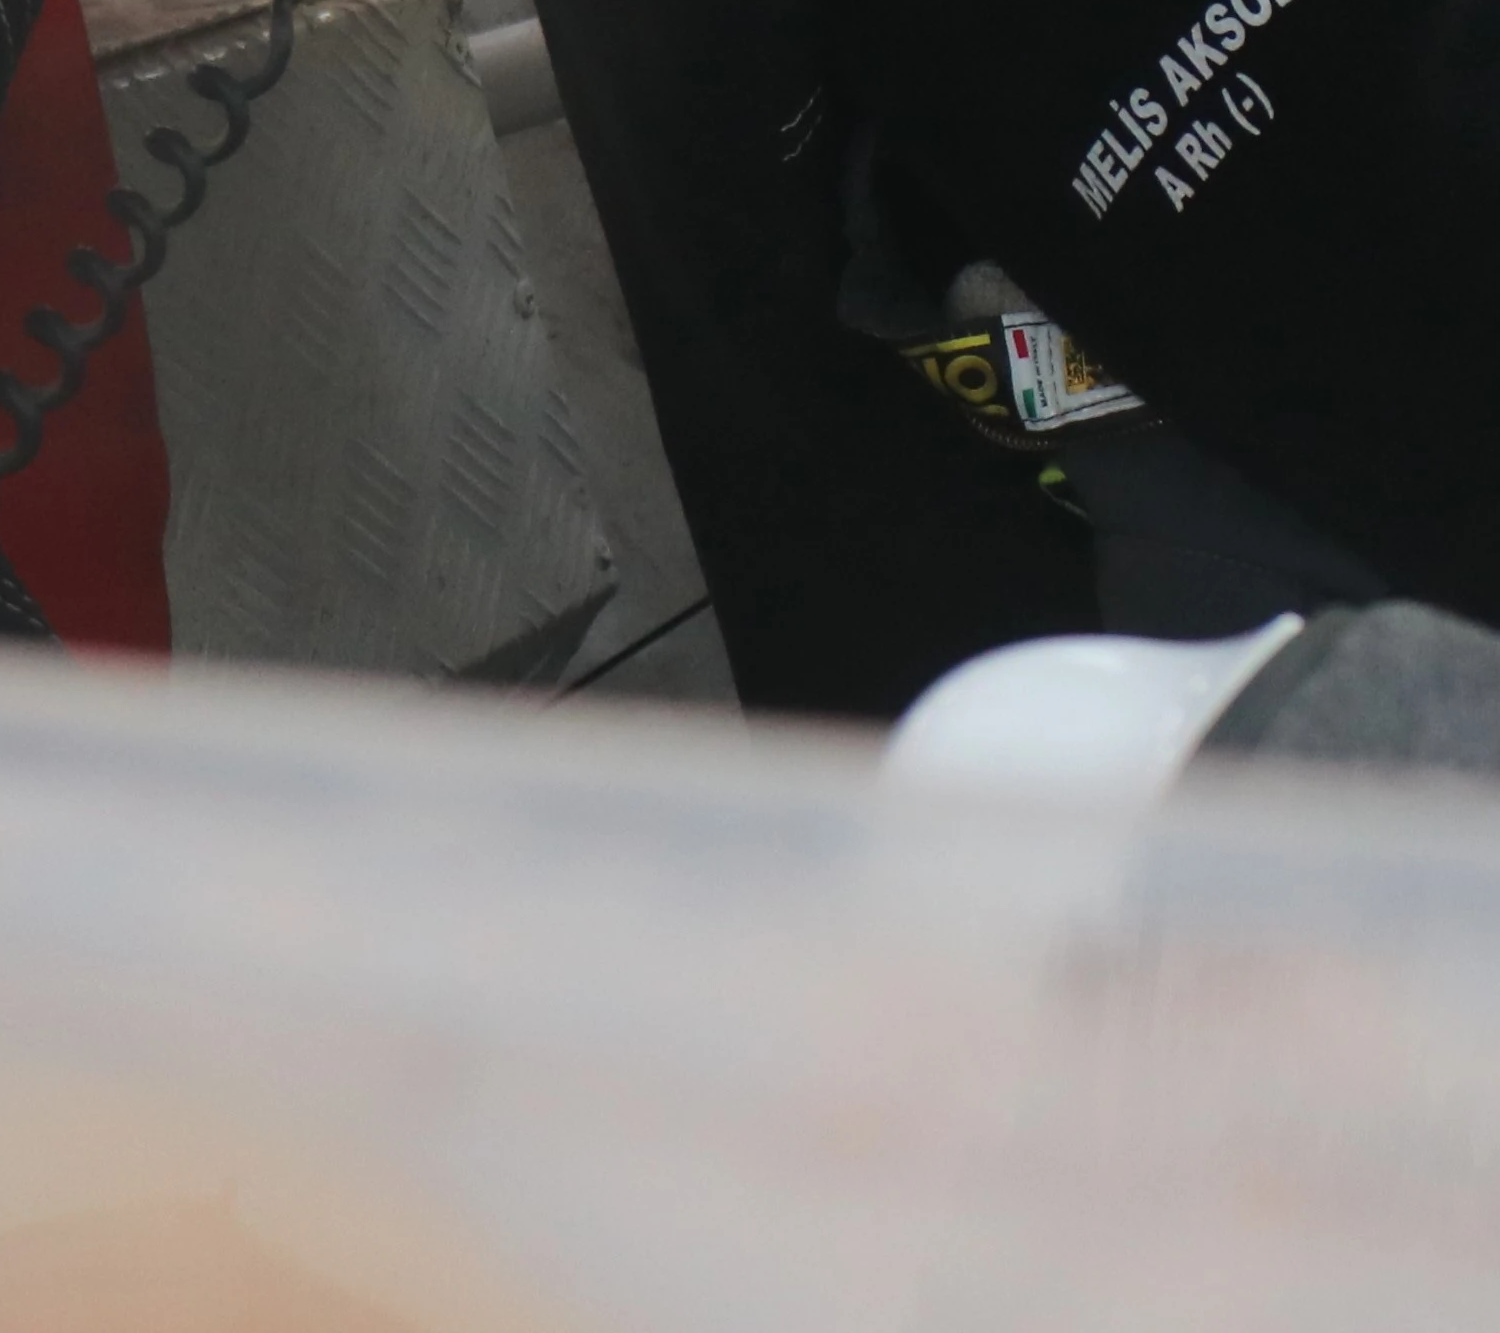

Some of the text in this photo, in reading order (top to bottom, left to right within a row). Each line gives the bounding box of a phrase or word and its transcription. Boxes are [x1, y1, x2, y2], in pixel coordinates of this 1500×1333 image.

[1072, 87, 1168, 220] MELİS
[1155, 166, 1195, 213] A
[1175, 120, 1233, 181] Rh
